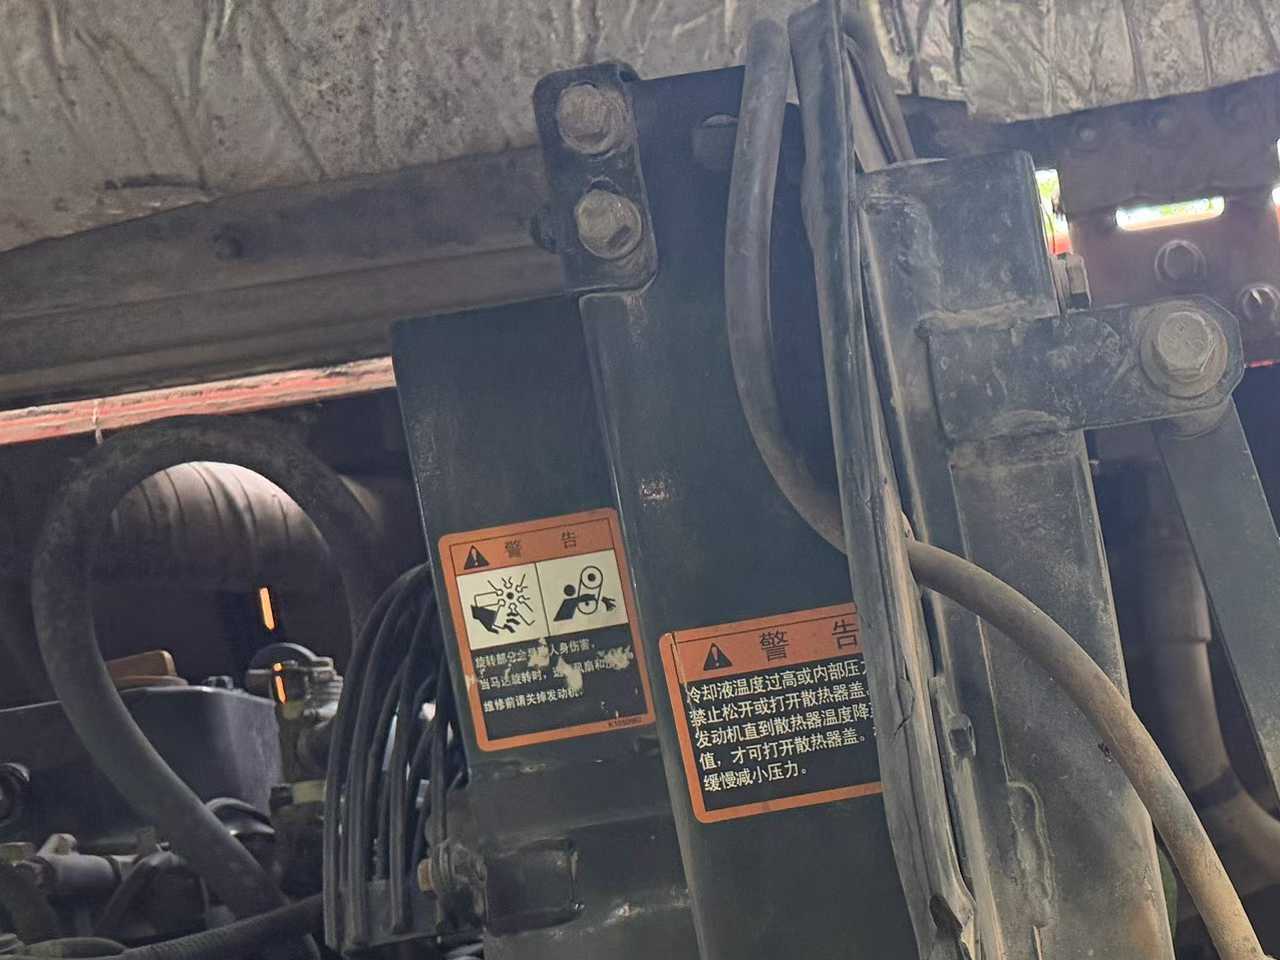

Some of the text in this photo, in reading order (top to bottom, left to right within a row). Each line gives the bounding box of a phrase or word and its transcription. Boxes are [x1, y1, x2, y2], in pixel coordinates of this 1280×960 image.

[505, 532, 577, 558] 警告
[760, 620, 858, 661] 警告
[704, 760, 807, 793] 缓慢减小压力。
